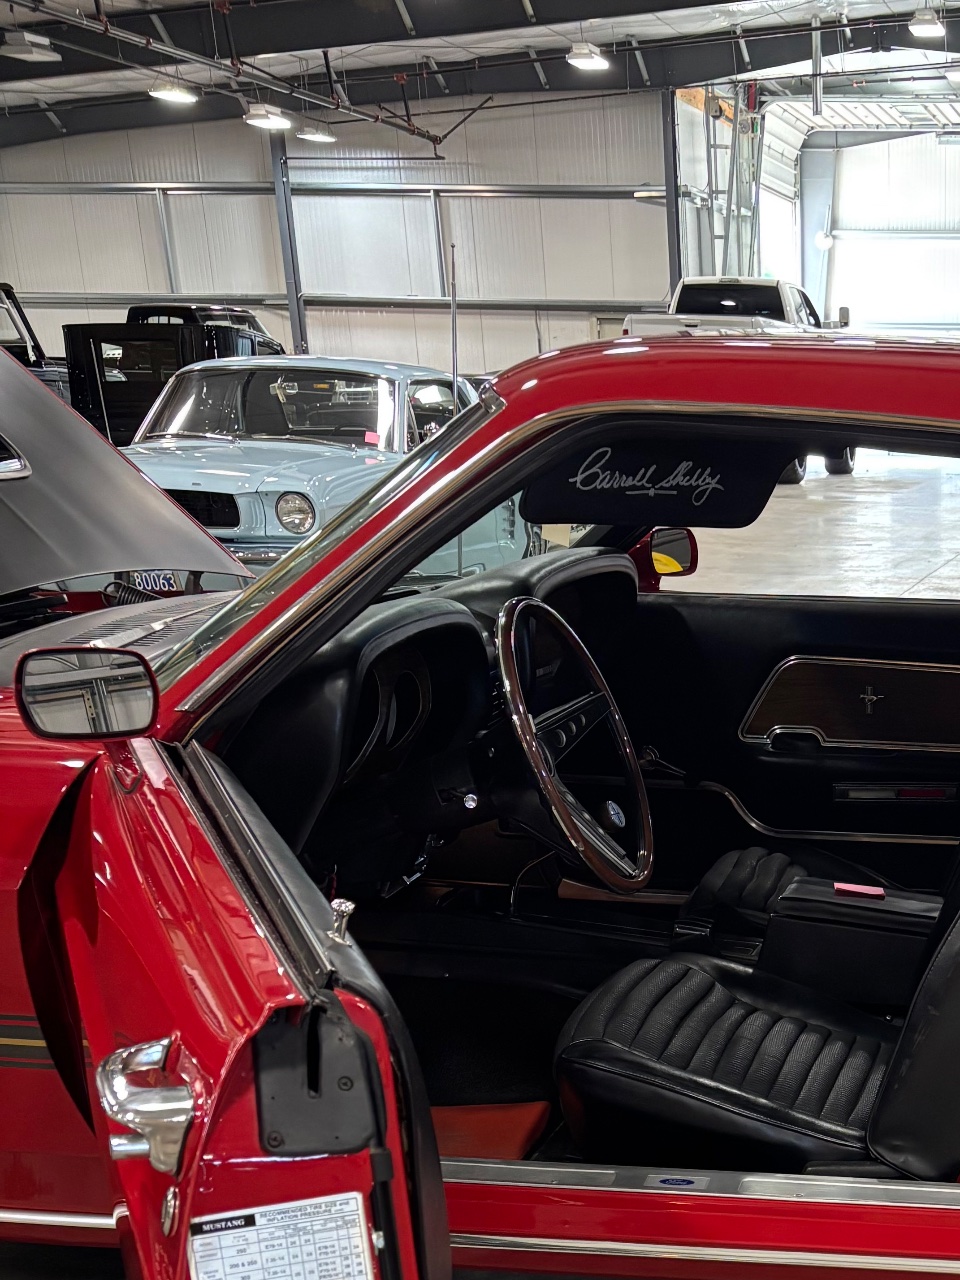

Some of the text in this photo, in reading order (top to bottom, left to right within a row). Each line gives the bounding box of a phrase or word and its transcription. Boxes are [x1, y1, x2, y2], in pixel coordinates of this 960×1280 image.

[569, 447, 724, 506] Carroll Shelby
[134, 572, 177, 591] 80063
[259, 1207, 308, 1218] RECOMMENDED
[266, 1213, 298, 1223] INFLATION
[299, 1208, 331, 1217] PRESSURE
[202, 1218, 245, 1231] MUSTANG
